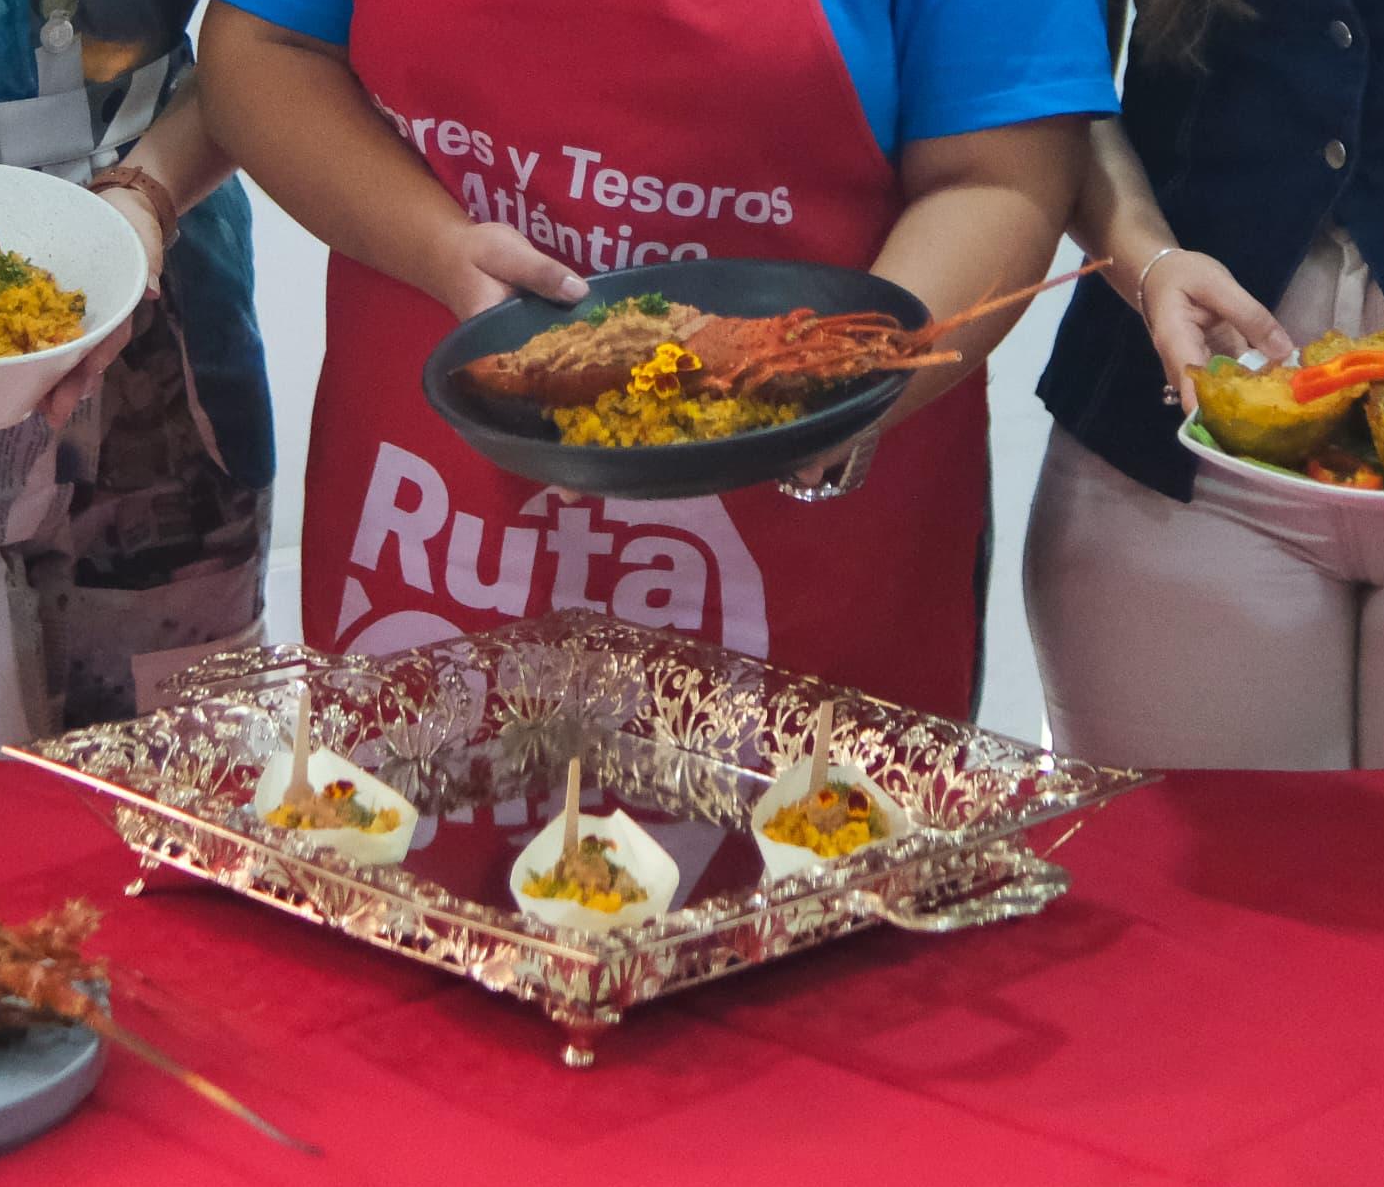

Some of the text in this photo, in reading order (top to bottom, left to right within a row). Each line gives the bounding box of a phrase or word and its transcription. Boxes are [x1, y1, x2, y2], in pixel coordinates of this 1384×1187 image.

[507, 145, 541, 191] y
[561, 145, 793, 226] Tesoros
[350, 441, 709, 630] Ruta
